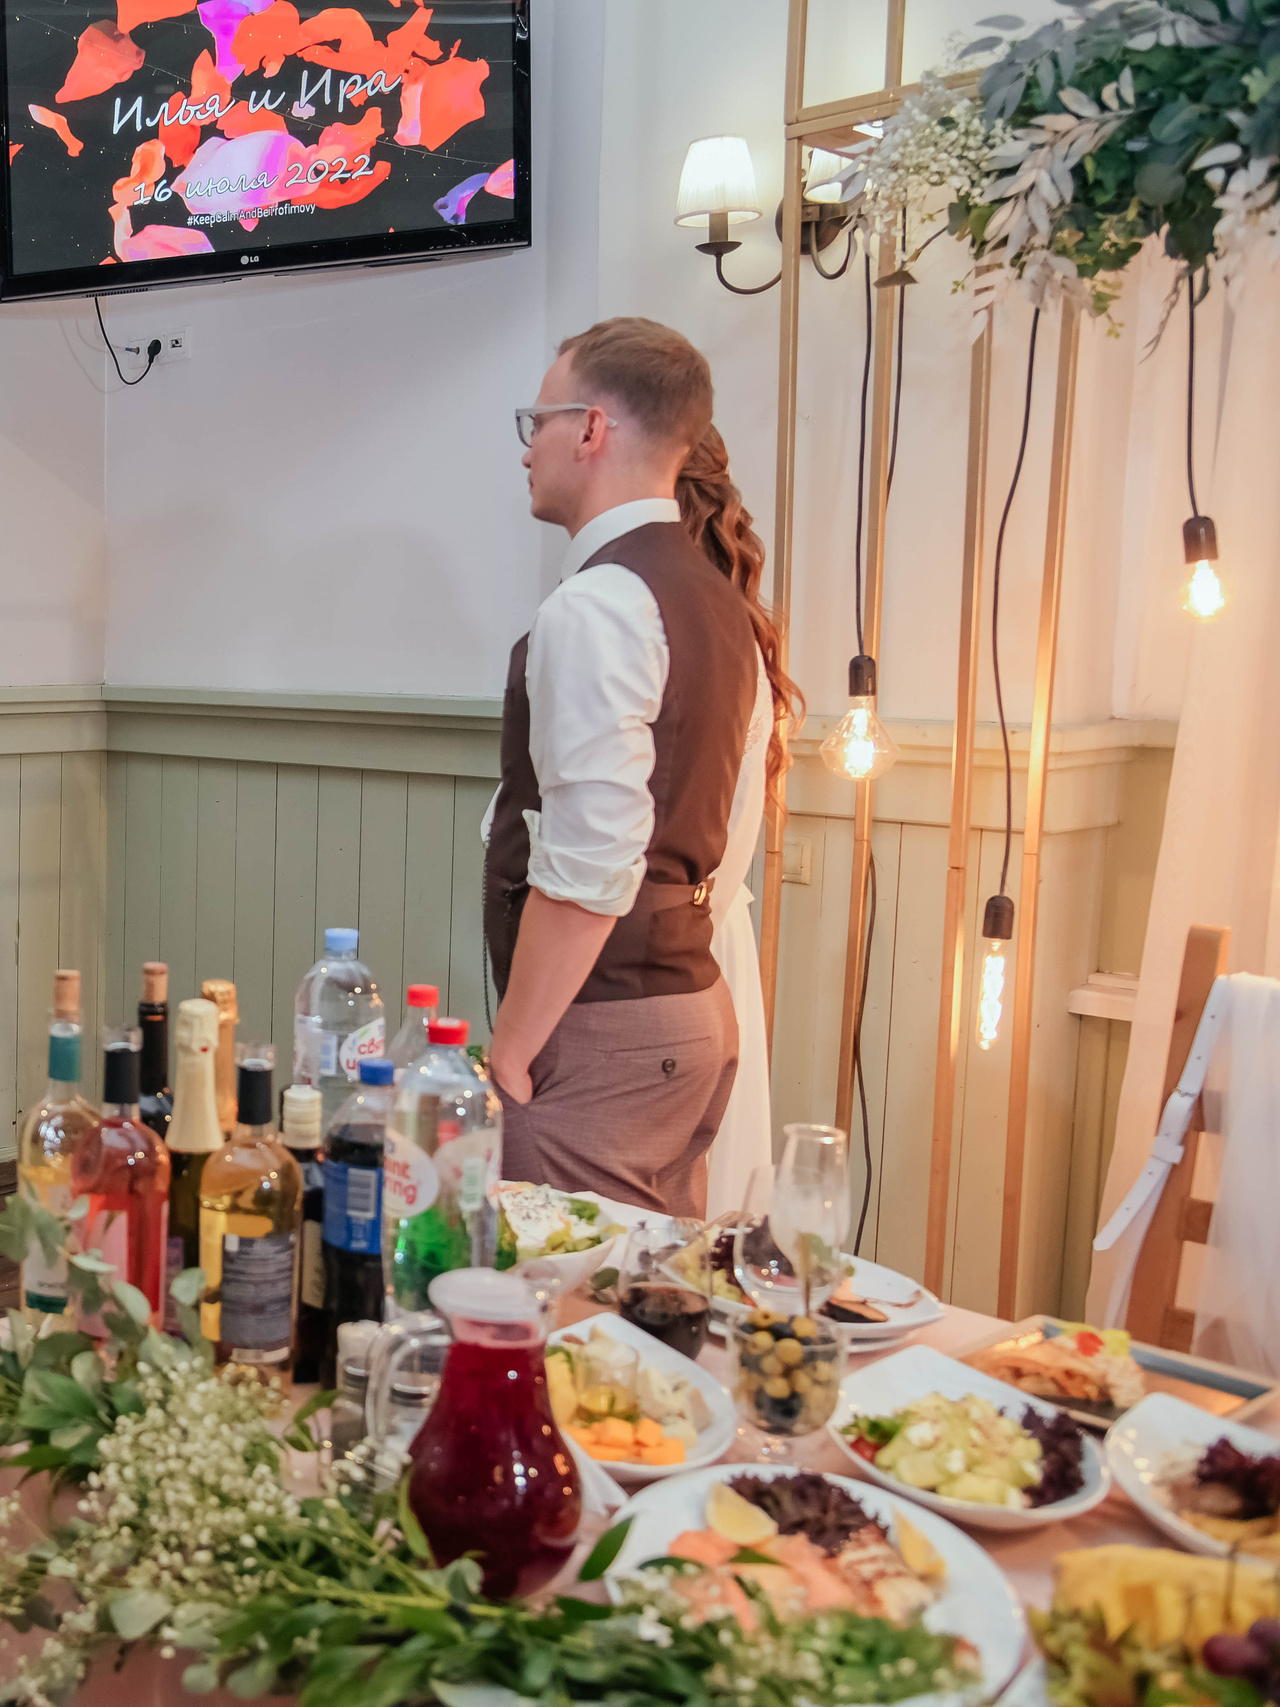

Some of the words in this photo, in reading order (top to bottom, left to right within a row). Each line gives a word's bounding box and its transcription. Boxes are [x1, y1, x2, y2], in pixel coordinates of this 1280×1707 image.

[112, 94, 236, 135] Илья
[248, 89, 286, 114] и
[299, 68, 403, 113] Ира
[133, 178, 173, 206] 16
[185, 171, 279, 199] июля
[285, 154, 375, 188] 2022
